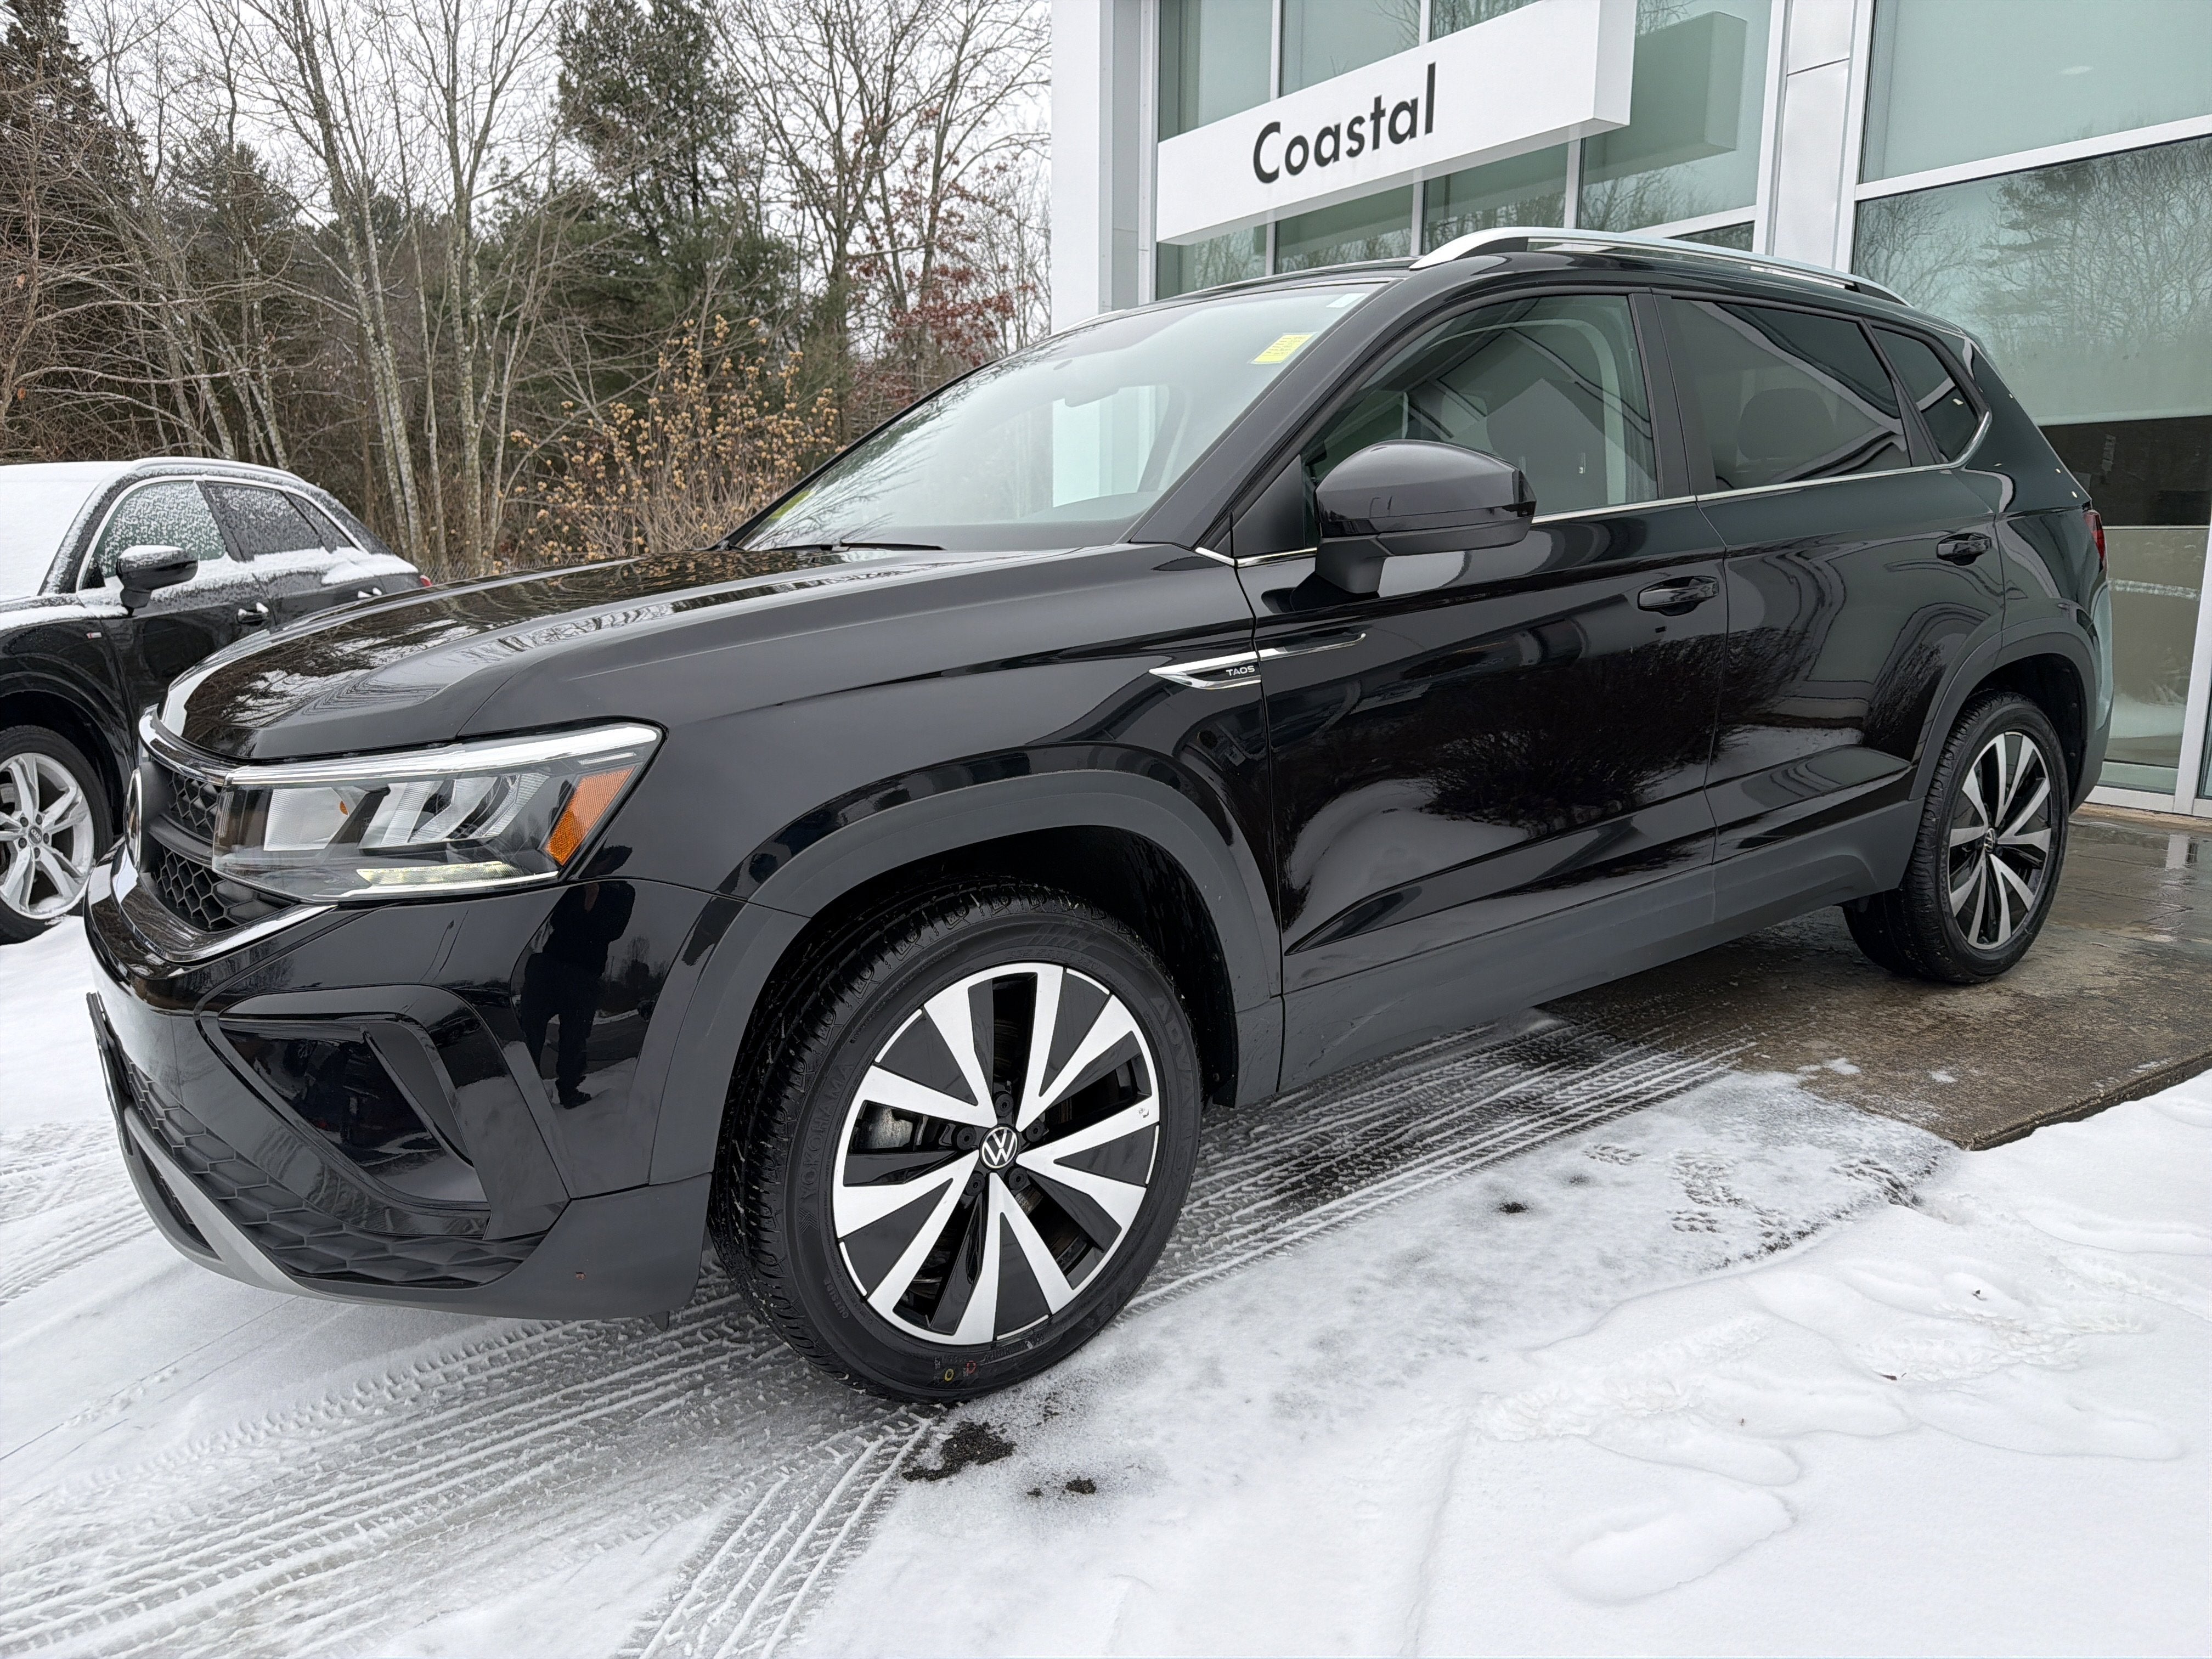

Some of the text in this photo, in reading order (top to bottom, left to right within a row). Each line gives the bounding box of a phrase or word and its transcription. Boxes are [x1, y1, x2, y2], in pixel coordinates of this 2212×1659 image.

[1253, 62, 1436, 184] Coastal
[1226, 665, 1255, 676] TAOS
[799, 1064, 854, 1203] YOKOHAMA
[982, 1126, 1018, 1169] VW
[823, 1277, 849, 1319] OUTSIDE
